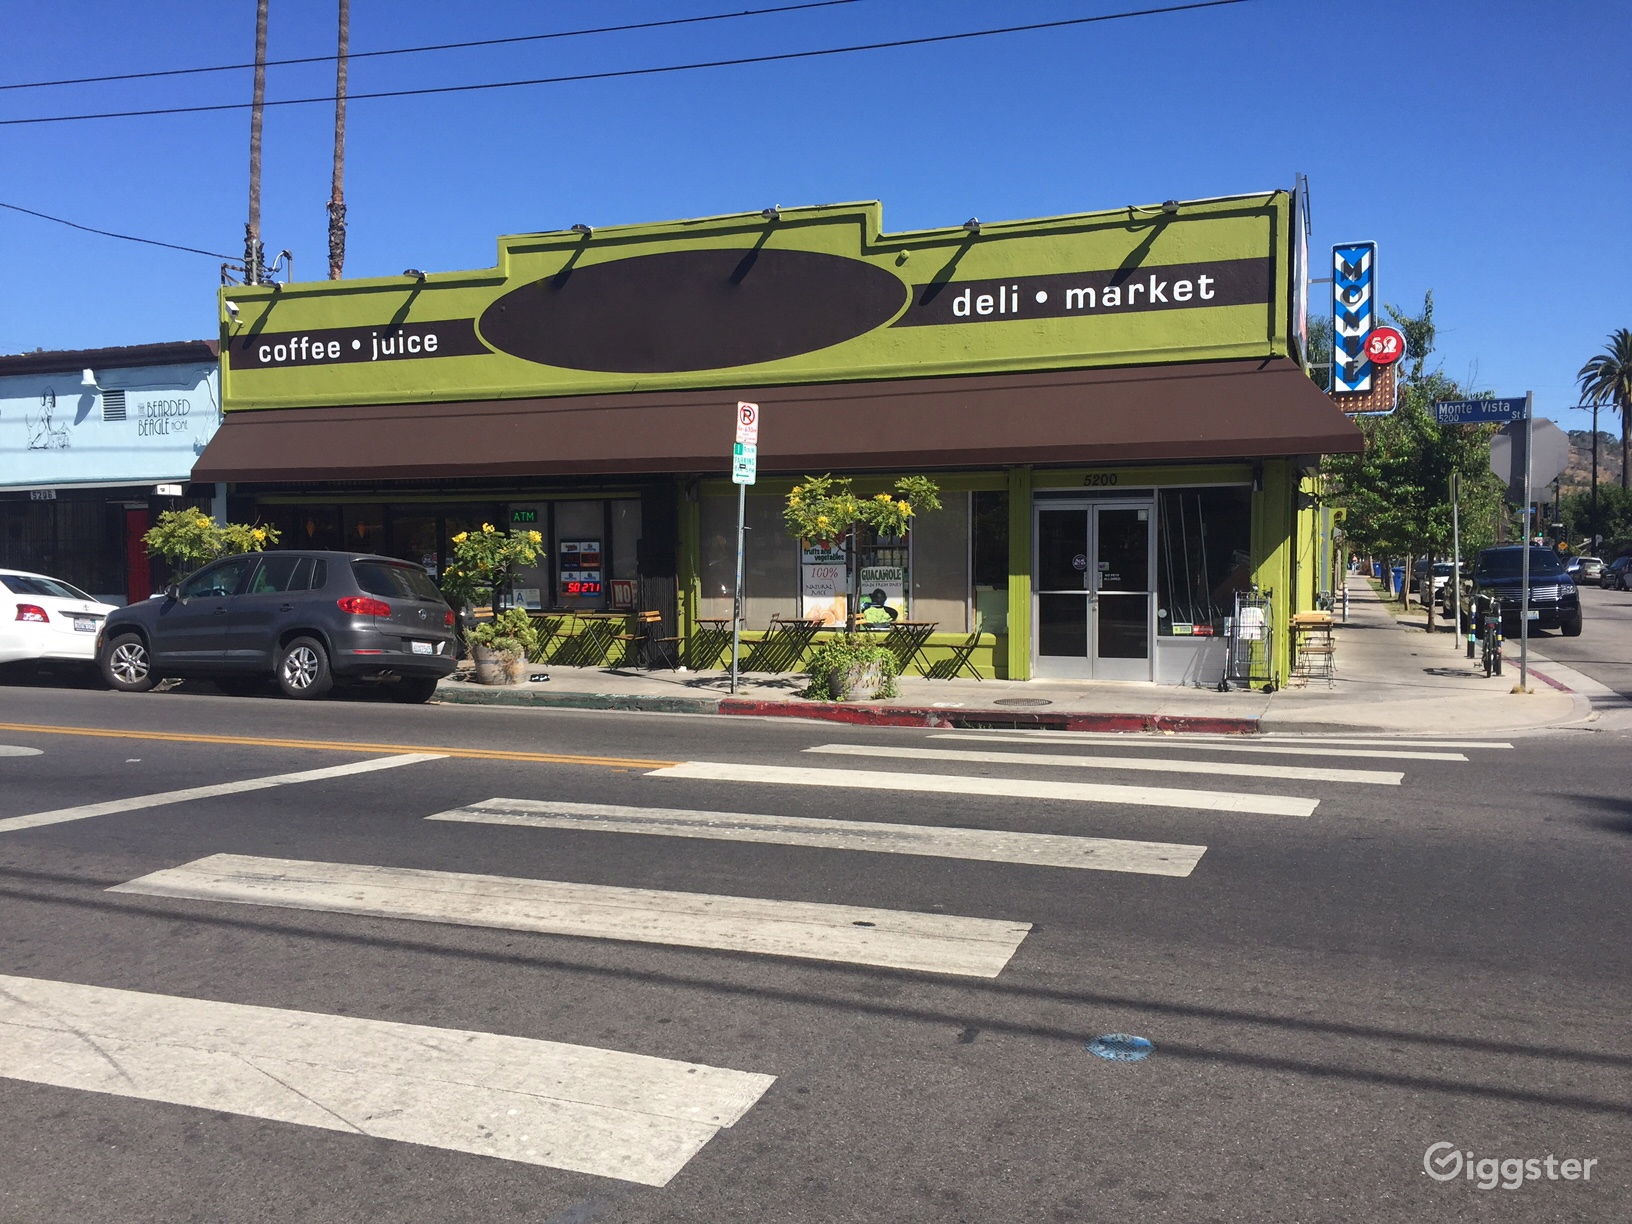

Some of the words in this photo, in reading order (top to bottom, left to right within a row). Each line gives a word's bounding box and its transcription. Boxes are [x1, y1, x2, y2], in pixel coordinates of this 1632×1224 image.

[952, 285, 1018, 317] deli
[1065, 274, 1215, 310] market
[258, 336, 341, 363] coffee
[371, 330, 438, 361] juice
[147, 399, 190, 417] BEARDED
[1439, 403, 1473, 415] Monte
[1480, 401, 1510, 413] Vista
[1511, 410, 1521, 419] St
[1438, 414, 1460, 423] 5200
[138, 418, 170, 436] BEAGLE
[1083, 473, 1118, 487] 5200
[513, 511, 535, 521] ATM
[811, 567, 839, 578] 100%
[861, 569, 902, 580] GUACAMOLE
[516, 592, 524, 602] A
[614, 584, 632, 603] NO
